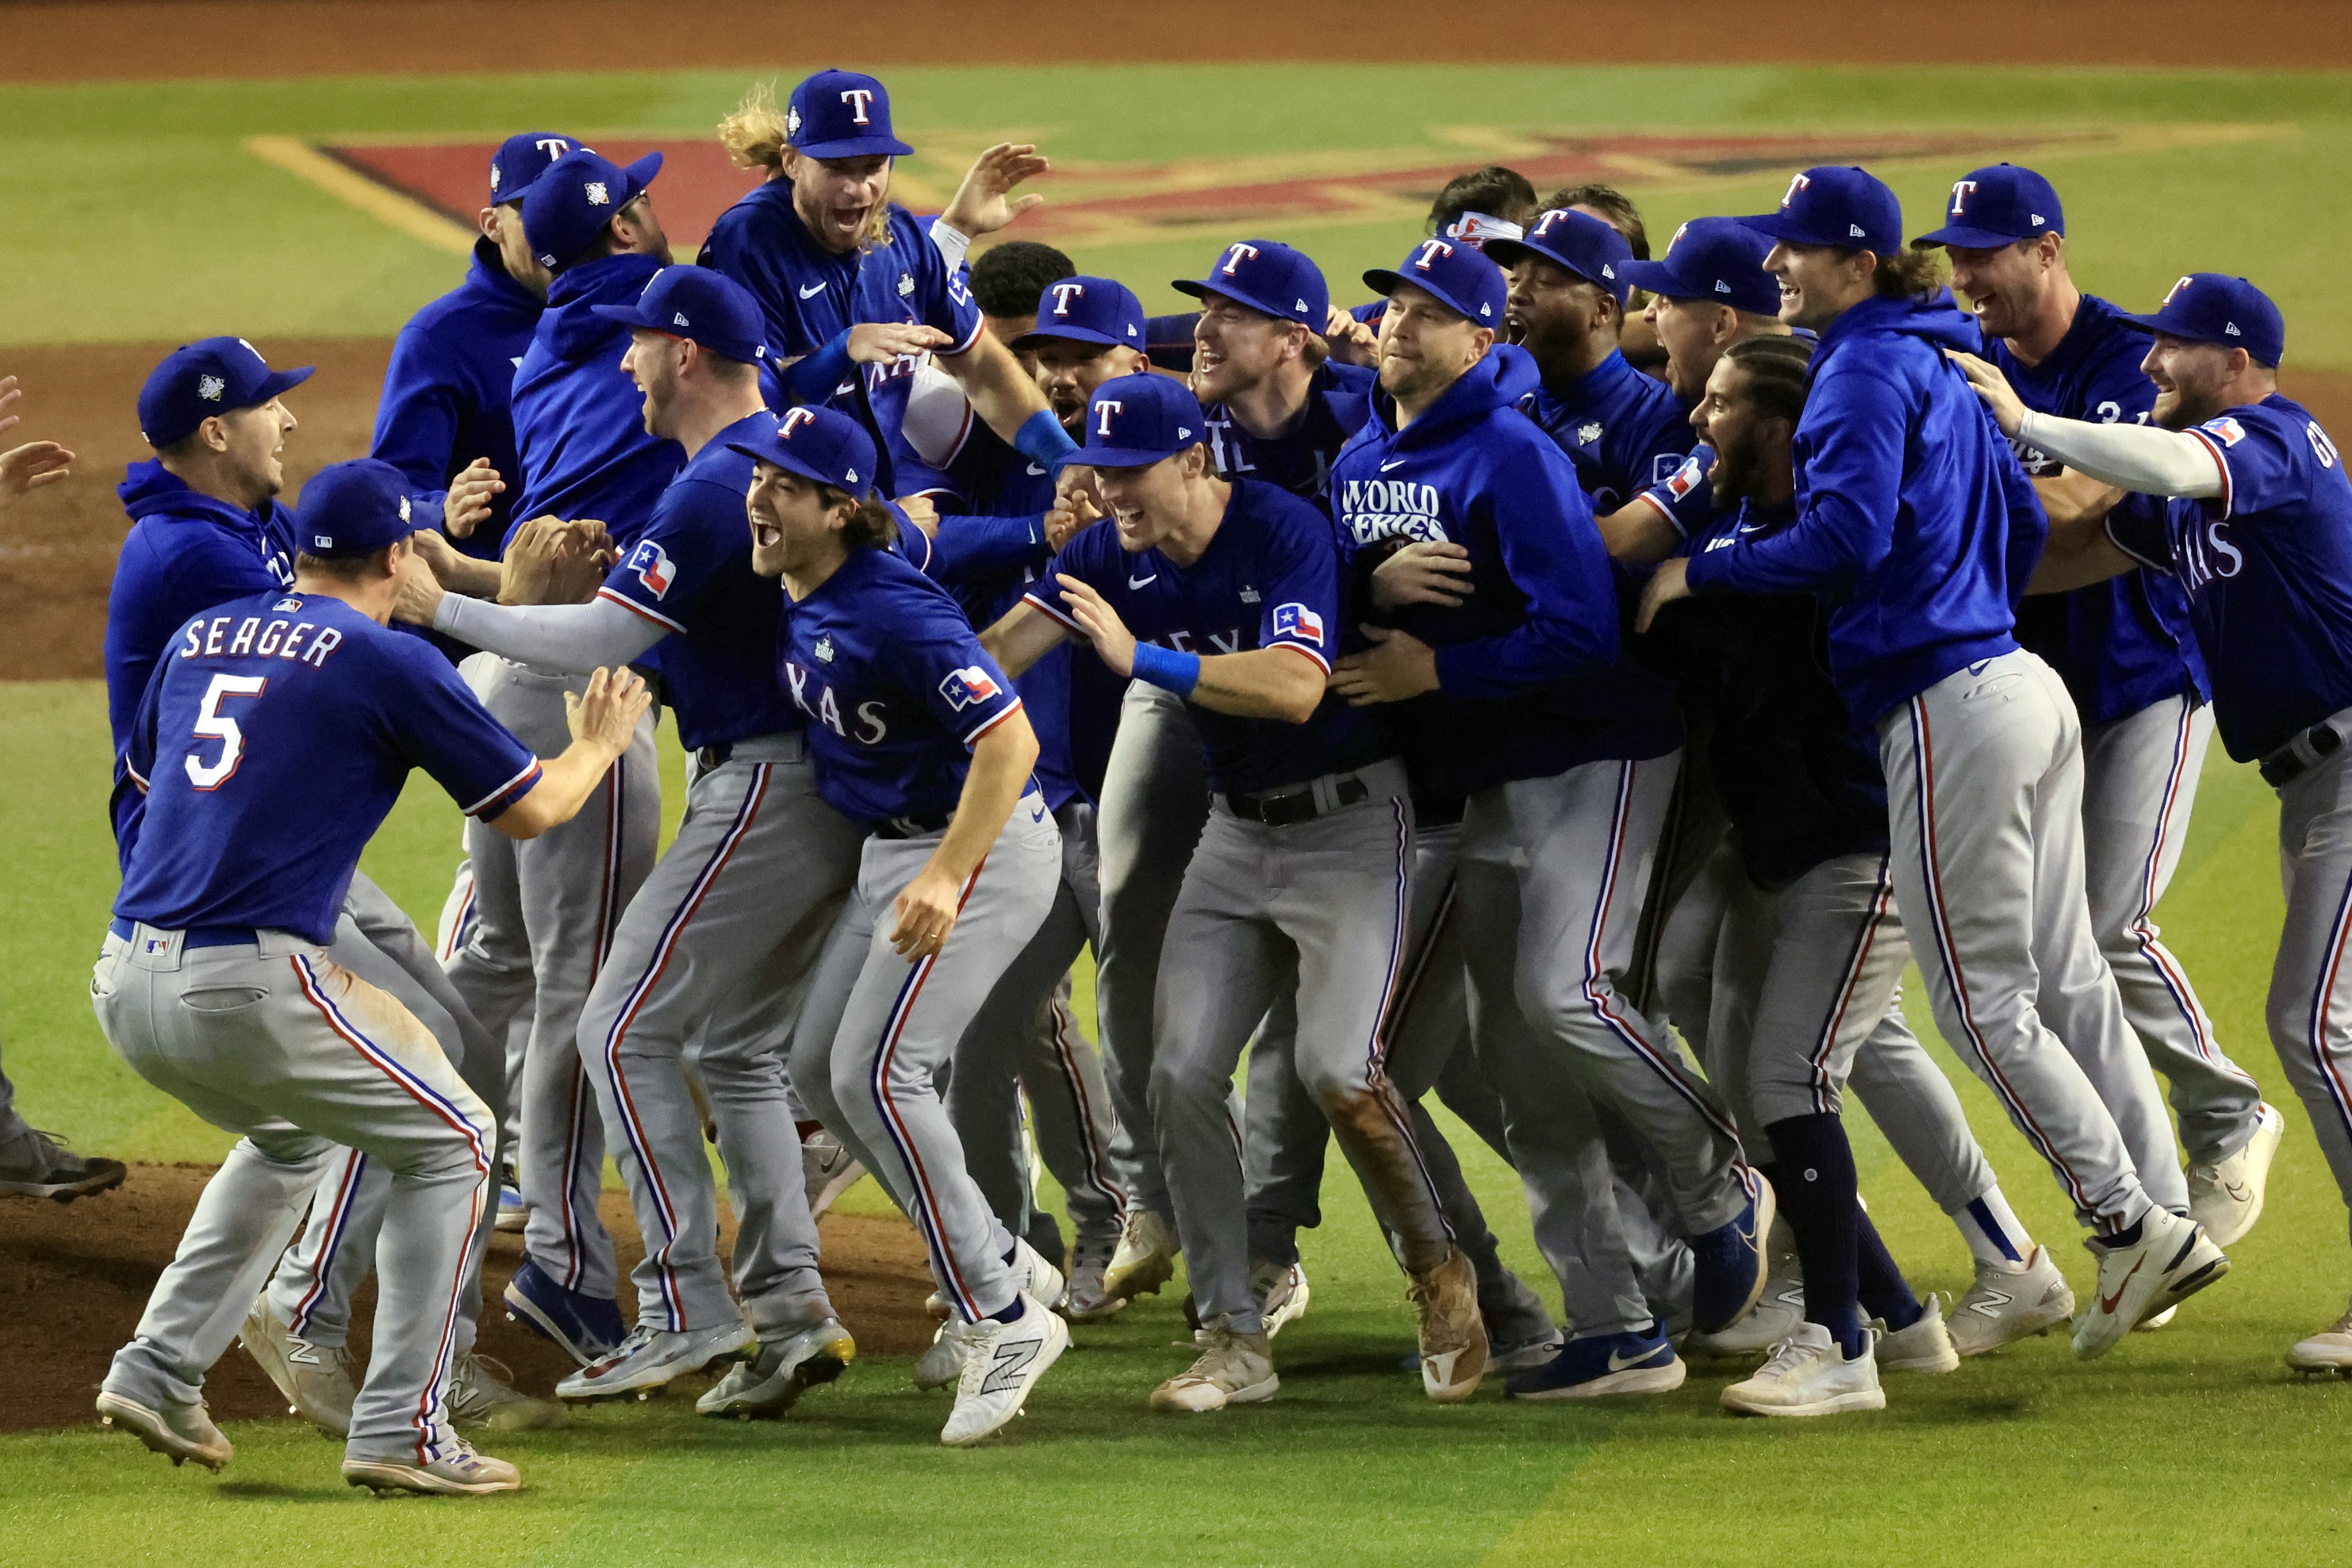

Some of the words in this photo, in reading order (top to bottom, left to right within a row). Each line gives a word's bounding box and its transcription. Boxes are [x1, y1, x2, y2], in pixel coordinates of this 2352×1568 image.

[841, 90, 873, 125] T
[1781, 173, 1810, 208] T
[1952, 181, 1977, 216] T
[1534, 210, 1570, 237] T
[1223, 243, 1259, 276] T
[1415, 239, 1453, 270] T
[1053, 284, 1085, 317] T
[2163, 276, 2194, 306] T
[777, 407, 815, 439] T
[1094, 401, 1124, 439] T
[1343, 480, 1439, 517] WORLD
[1342, 513, 1449, 544] SERIES
[181, 617, 345, 671] SEAGER
[784, 661, 887, 745] XAS
[184, 673, 269, 792] 5
